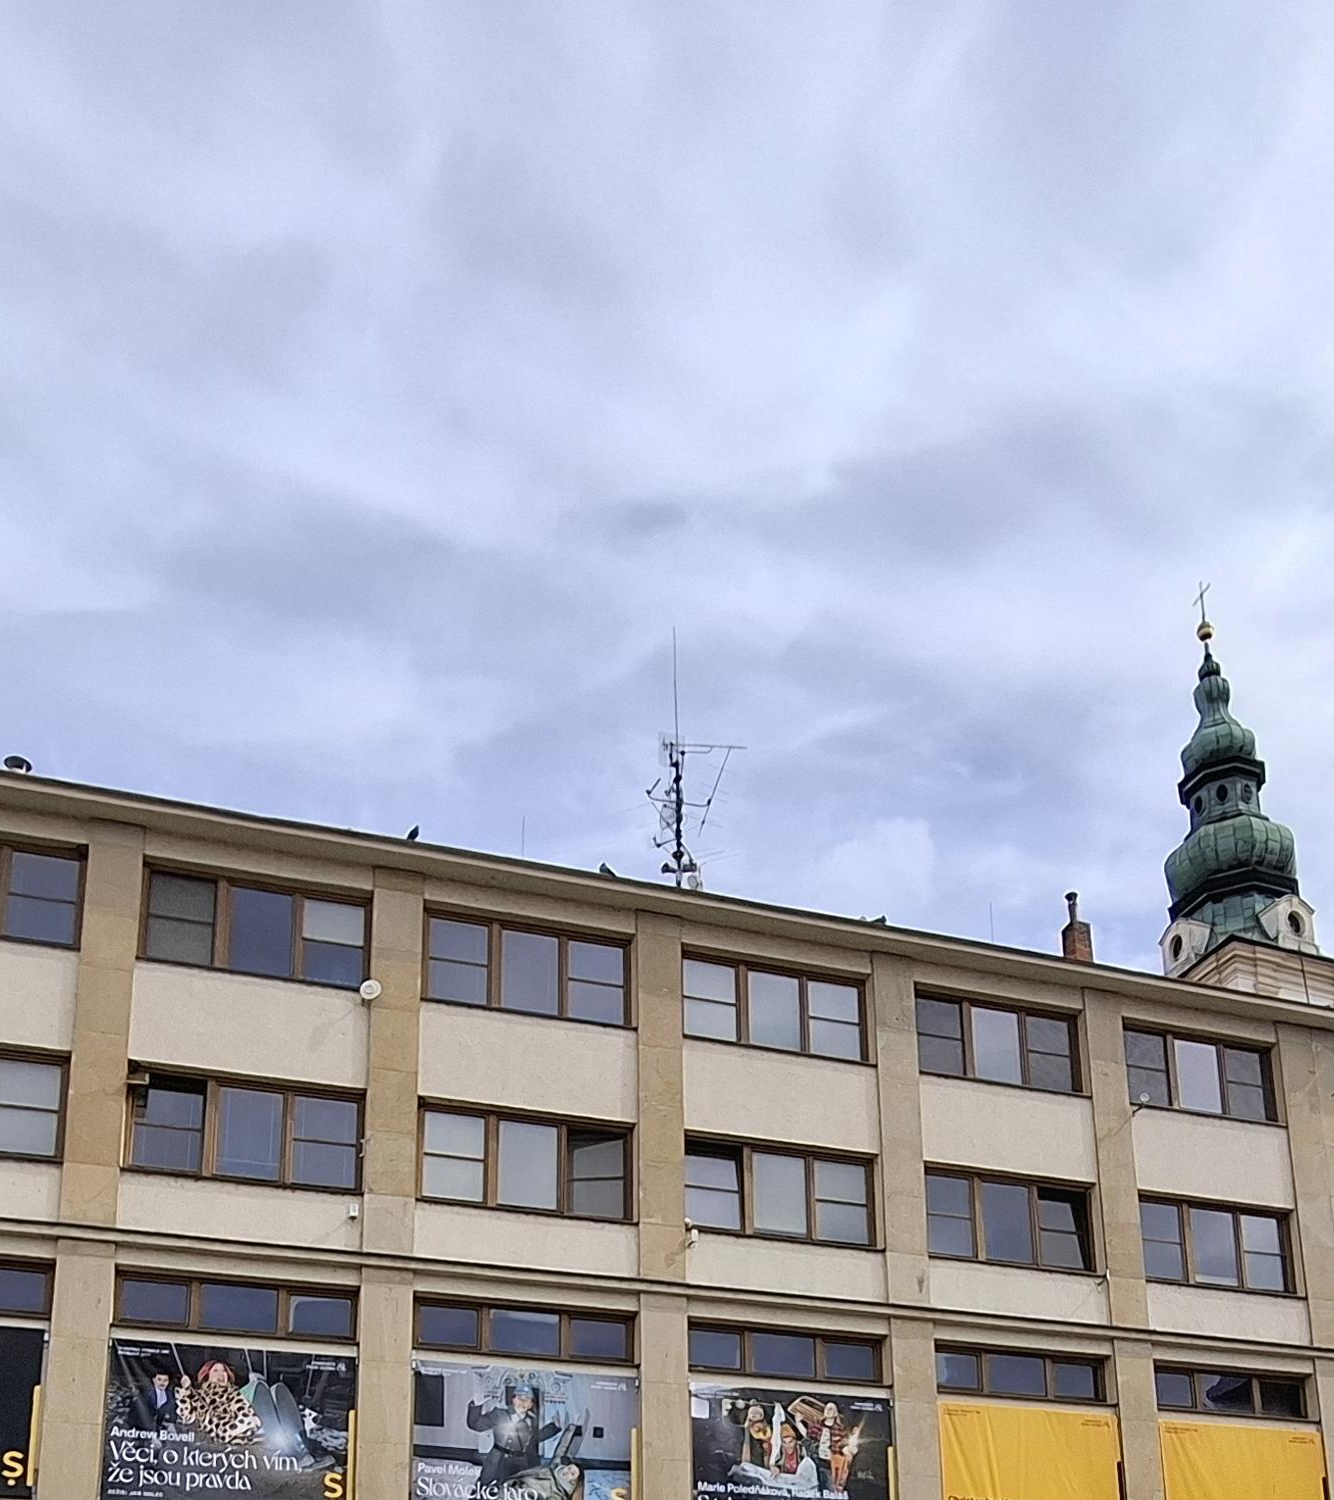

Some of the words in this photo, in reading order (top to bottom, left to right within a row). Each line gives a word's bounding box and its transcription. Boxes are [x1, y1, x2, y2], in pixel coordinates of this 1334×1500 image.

[110, 1426, 158, 1440] Andrew
[159, 1429, 195, 1443] Bovell
[109, 1440, 158, 1465] Věci,
[163, 1449, 179, 1465] o
[182, 1446, 257, 1473] kterých
[263, 1449, 302, 1473] vím,
[107, 1462, 134, 1484] že
[138, 1465, 181, 1488] jsou
[185, 1470, 252, 1491] pravda
[417, 1462, 446, 1474] Pavel
[416, 1476, 499, 1500] Slovácké
[697, 1480, 725, 1493] Marie
